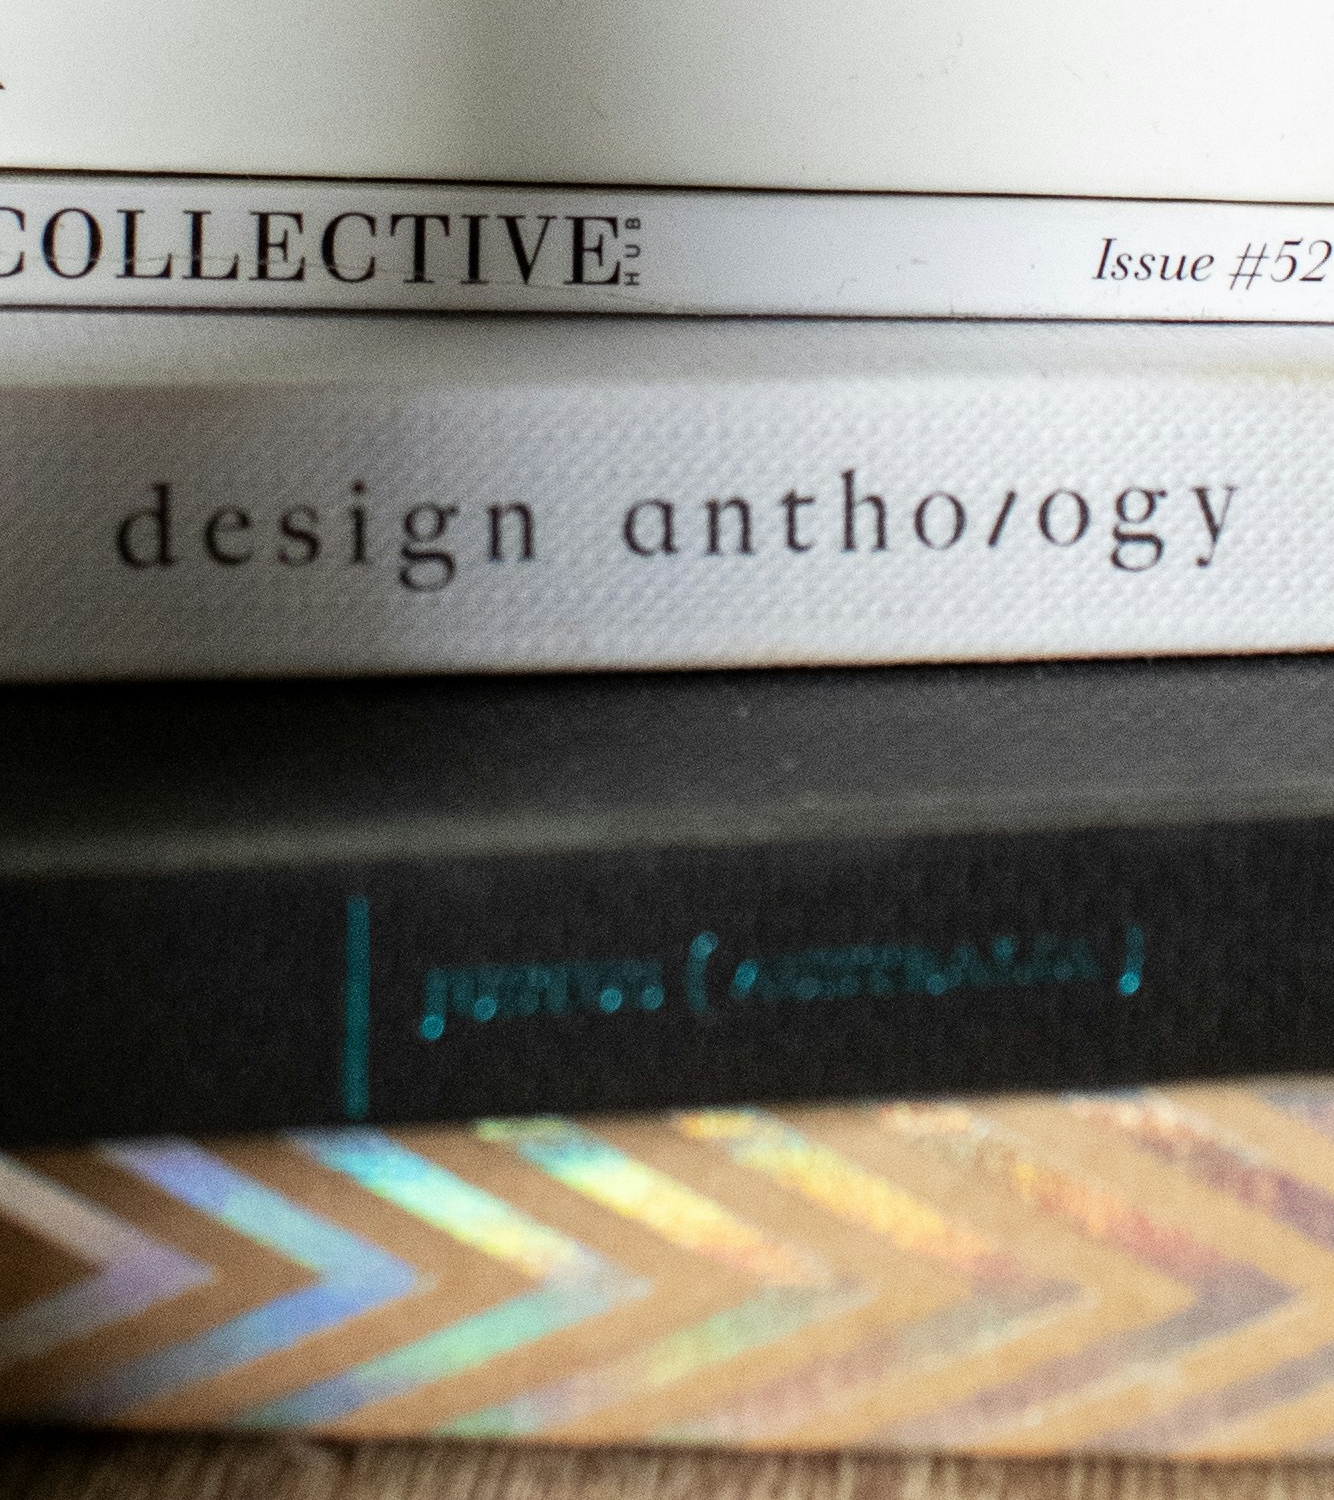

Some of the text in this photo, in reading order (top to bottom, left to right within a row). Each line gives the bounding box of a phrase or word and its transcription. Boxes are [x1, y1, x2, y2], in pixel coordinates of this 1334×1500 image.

[1094, 237, 1334, 290] Issue #52
[115, 478, 537, 595] design
